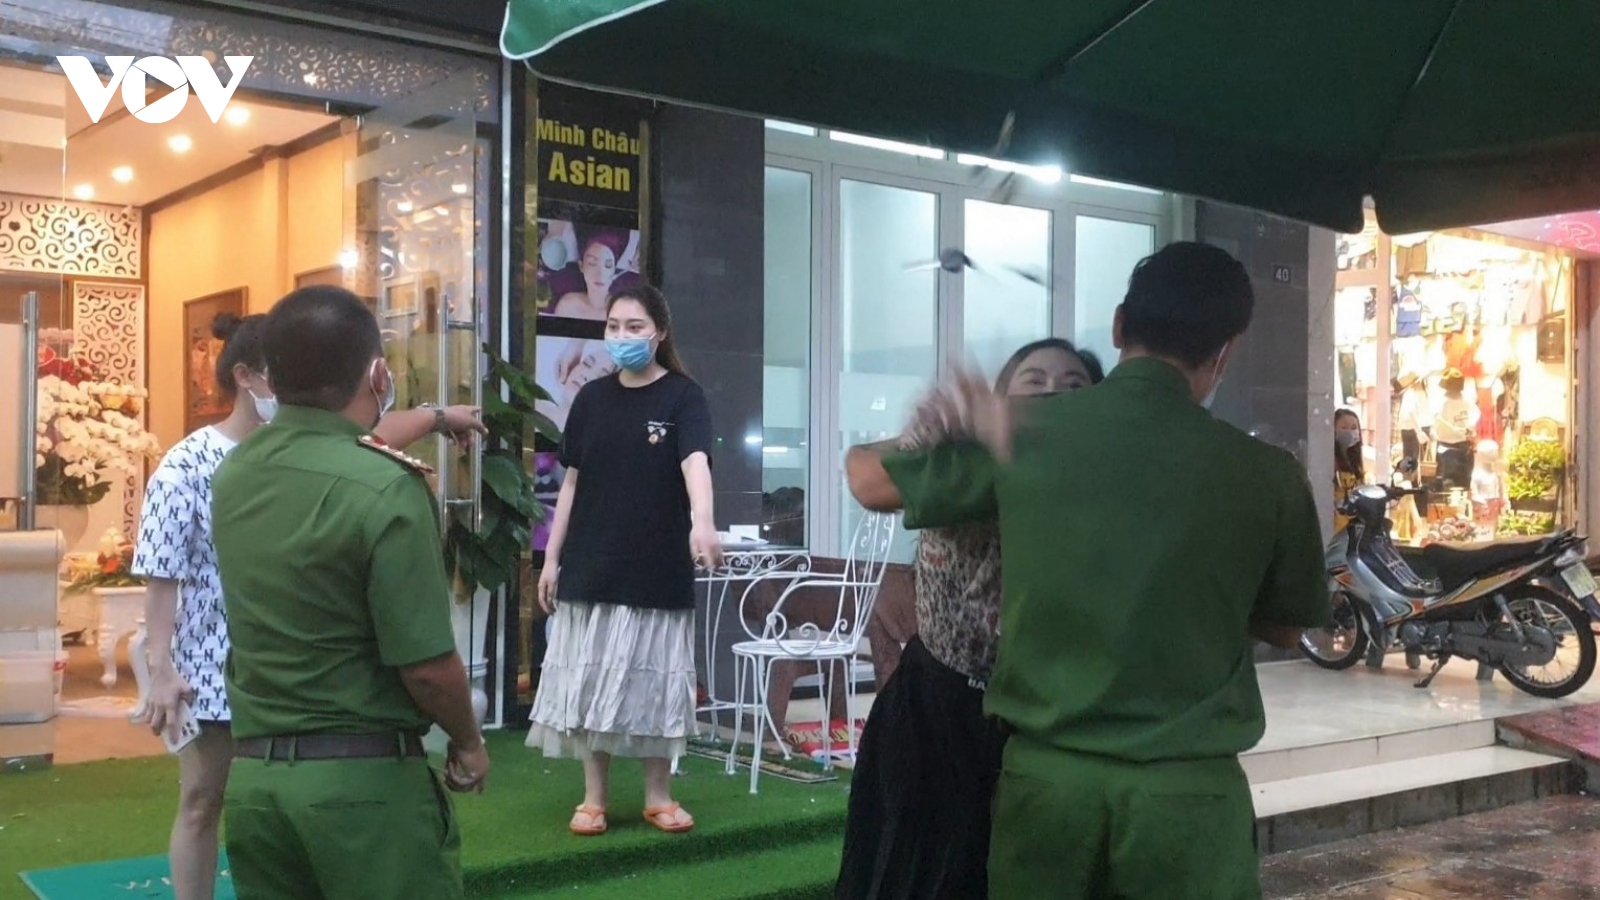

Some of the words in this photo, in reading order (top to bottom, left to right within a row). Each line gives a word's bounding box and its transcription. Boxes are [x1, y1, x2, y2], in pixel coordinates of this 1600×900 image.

[537, 118, 585, 147] Minh
[592, 127, 640, 156] Châu
[548, 151, 630, 192] Asian
[1275, 267, 1289, 282] 40
[195, 450, 207, 464] N
[212, 447, 224, 461] N
[147, 488, 155, 503] Y
[164, 491, 172, 504] Y
[150, 502, 160, 517] N
[168, 506, 179, 520] N
[142, 528, 154, 543] N
[164, 531, 174, 545] N
[152, 542, 161, 557] Y
[135, 554, 146, 568] N
[157, 557, 170, 571] N
[200, 575, 210, 588] N
[186, 611, 195, 624] Y
[206, 622, 217, 636] N
[197, 636, 205, 649] Y
[218, 635, 227, 649] Y
[183, 649, 193, 663] N
[204, 648, 214, 662] N
[193, 662, 202, 676] Y
[216, 661, 224, 675] Y
[202, 674, 213, 687] N
[213, 686, 223, 700] Y
[200, 698, 210, 712] N
